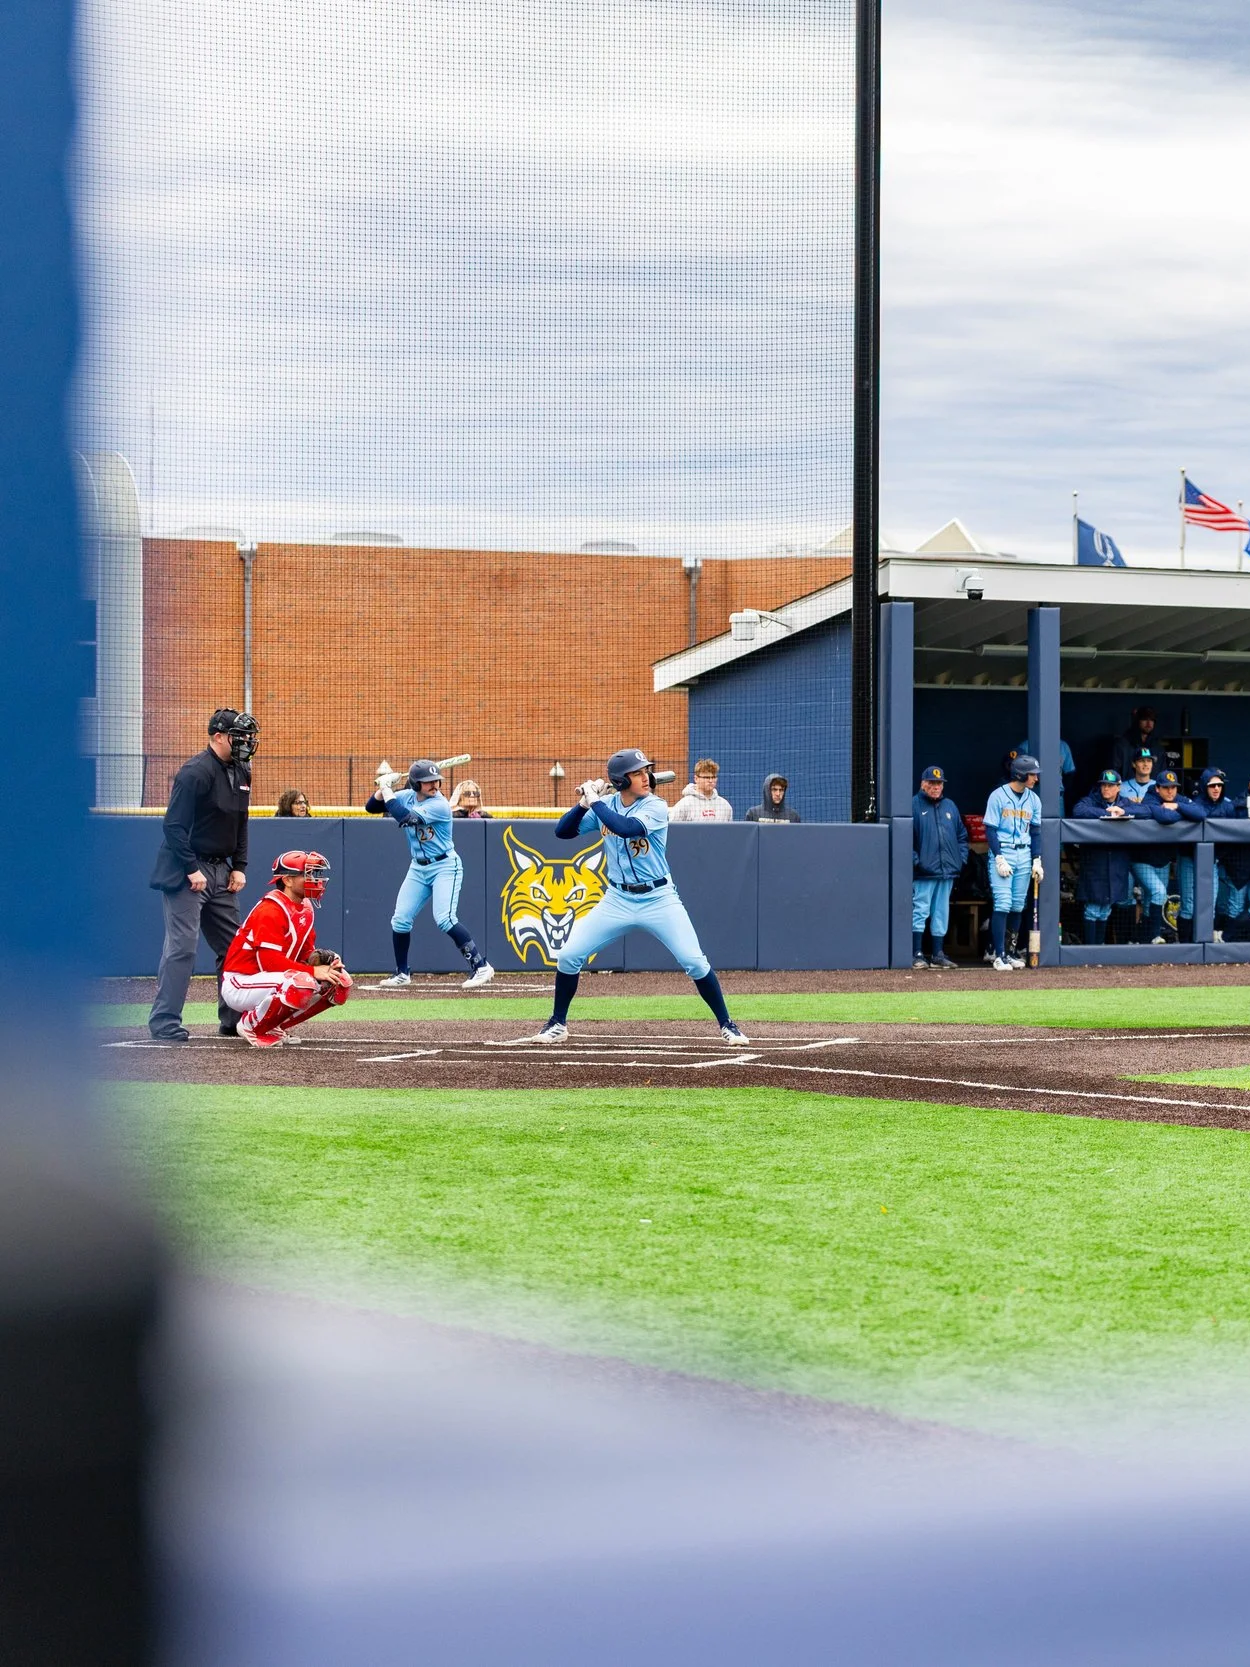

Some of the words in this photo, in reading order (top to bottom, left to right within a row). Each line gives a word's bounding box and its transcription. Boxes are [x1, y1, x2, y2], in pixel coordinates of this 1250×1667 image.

[635, 751, 647, 762] Q
[429, 766, 438, 775] Q
[932, 768, 942, 778] Q
[1166, 772, 1176, 782] Q
[419, 826, 435, 841] 23
[629, 837, 650, 858] 39
